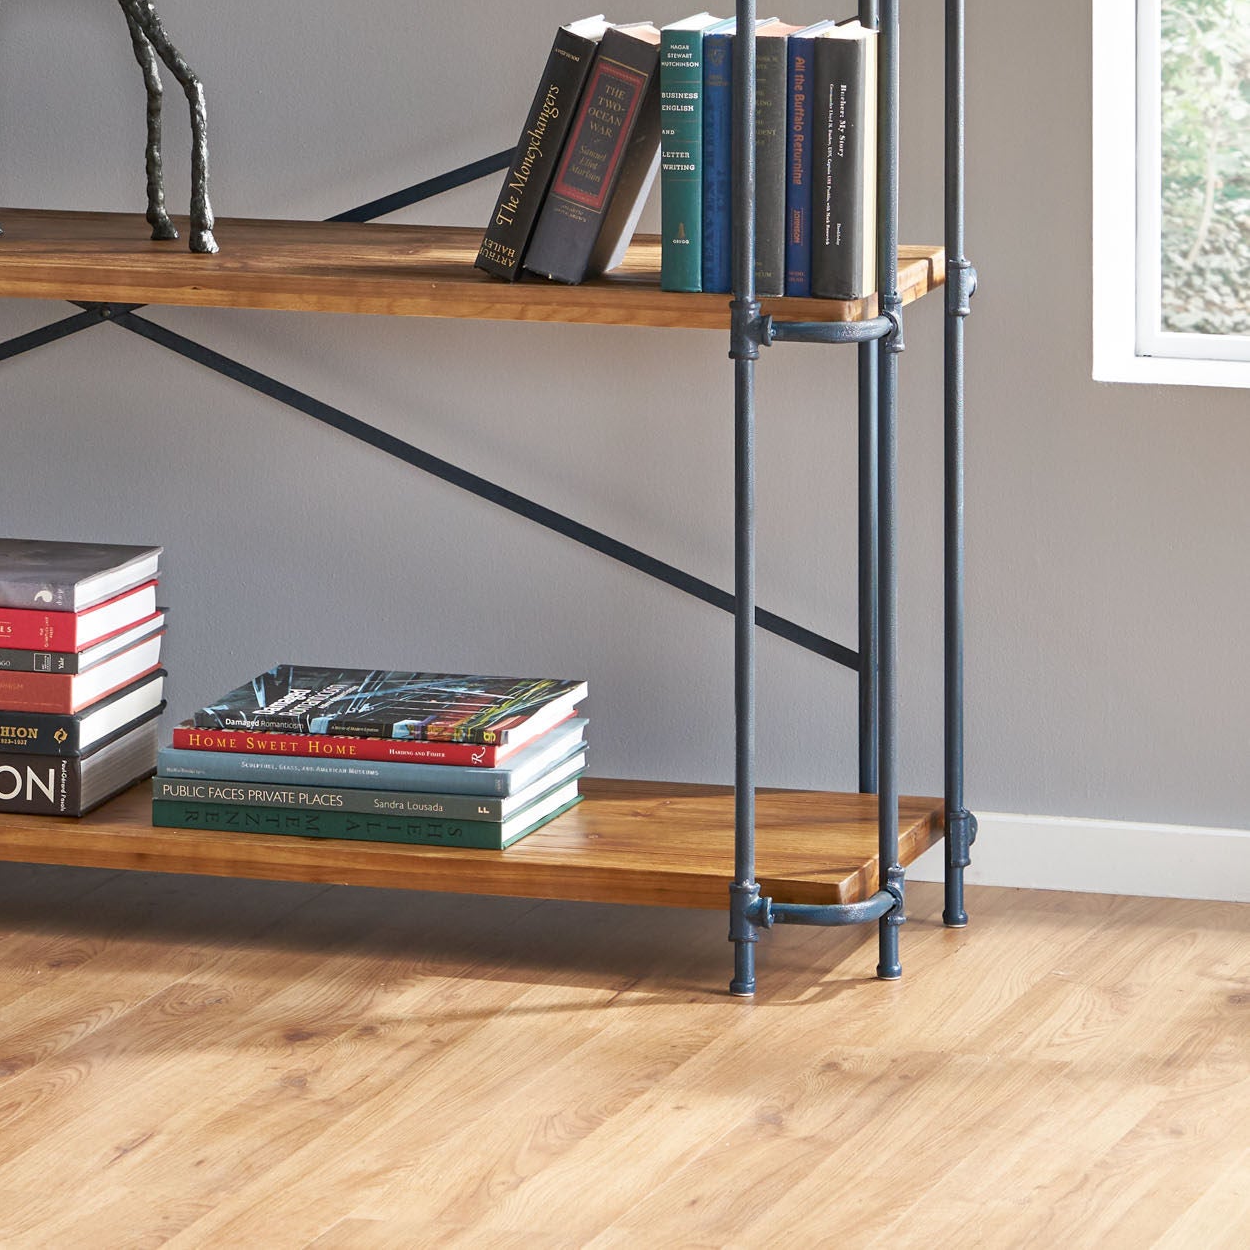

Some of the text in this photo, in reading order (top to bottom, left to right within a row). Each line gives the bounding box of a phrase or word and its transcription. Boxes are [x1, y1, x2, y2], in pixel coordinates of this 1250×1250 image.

[605, 84, 626, 100] THE
[661, 92, 699, 100] BUSINESS
[661, 104, 694, 112] ENGLISH
[588, 107, 622, 127] OCEAN
[792, 57, 806, 185] All the Buffalo Returning
[589, 120, 613, 138] WAR
[838, 120, 846, 133] My
[580, 145, 607, 162] Samuel
[837, 134, 846, 158] Story
[496, 84, 560, 226] The Moneychangers
[662, 151, 690, 159] LETTER
[57, 657, 65, 670] Yale
[225, 718, 304, 731] Damaged Romanticism
[189, 733, 357, 755] HOME SWEET HOME
[162, 784, 344, 807] PUBLIC FACES PRIVATE PLACES
[374, 798, 444, 812] Sandra Lousada
